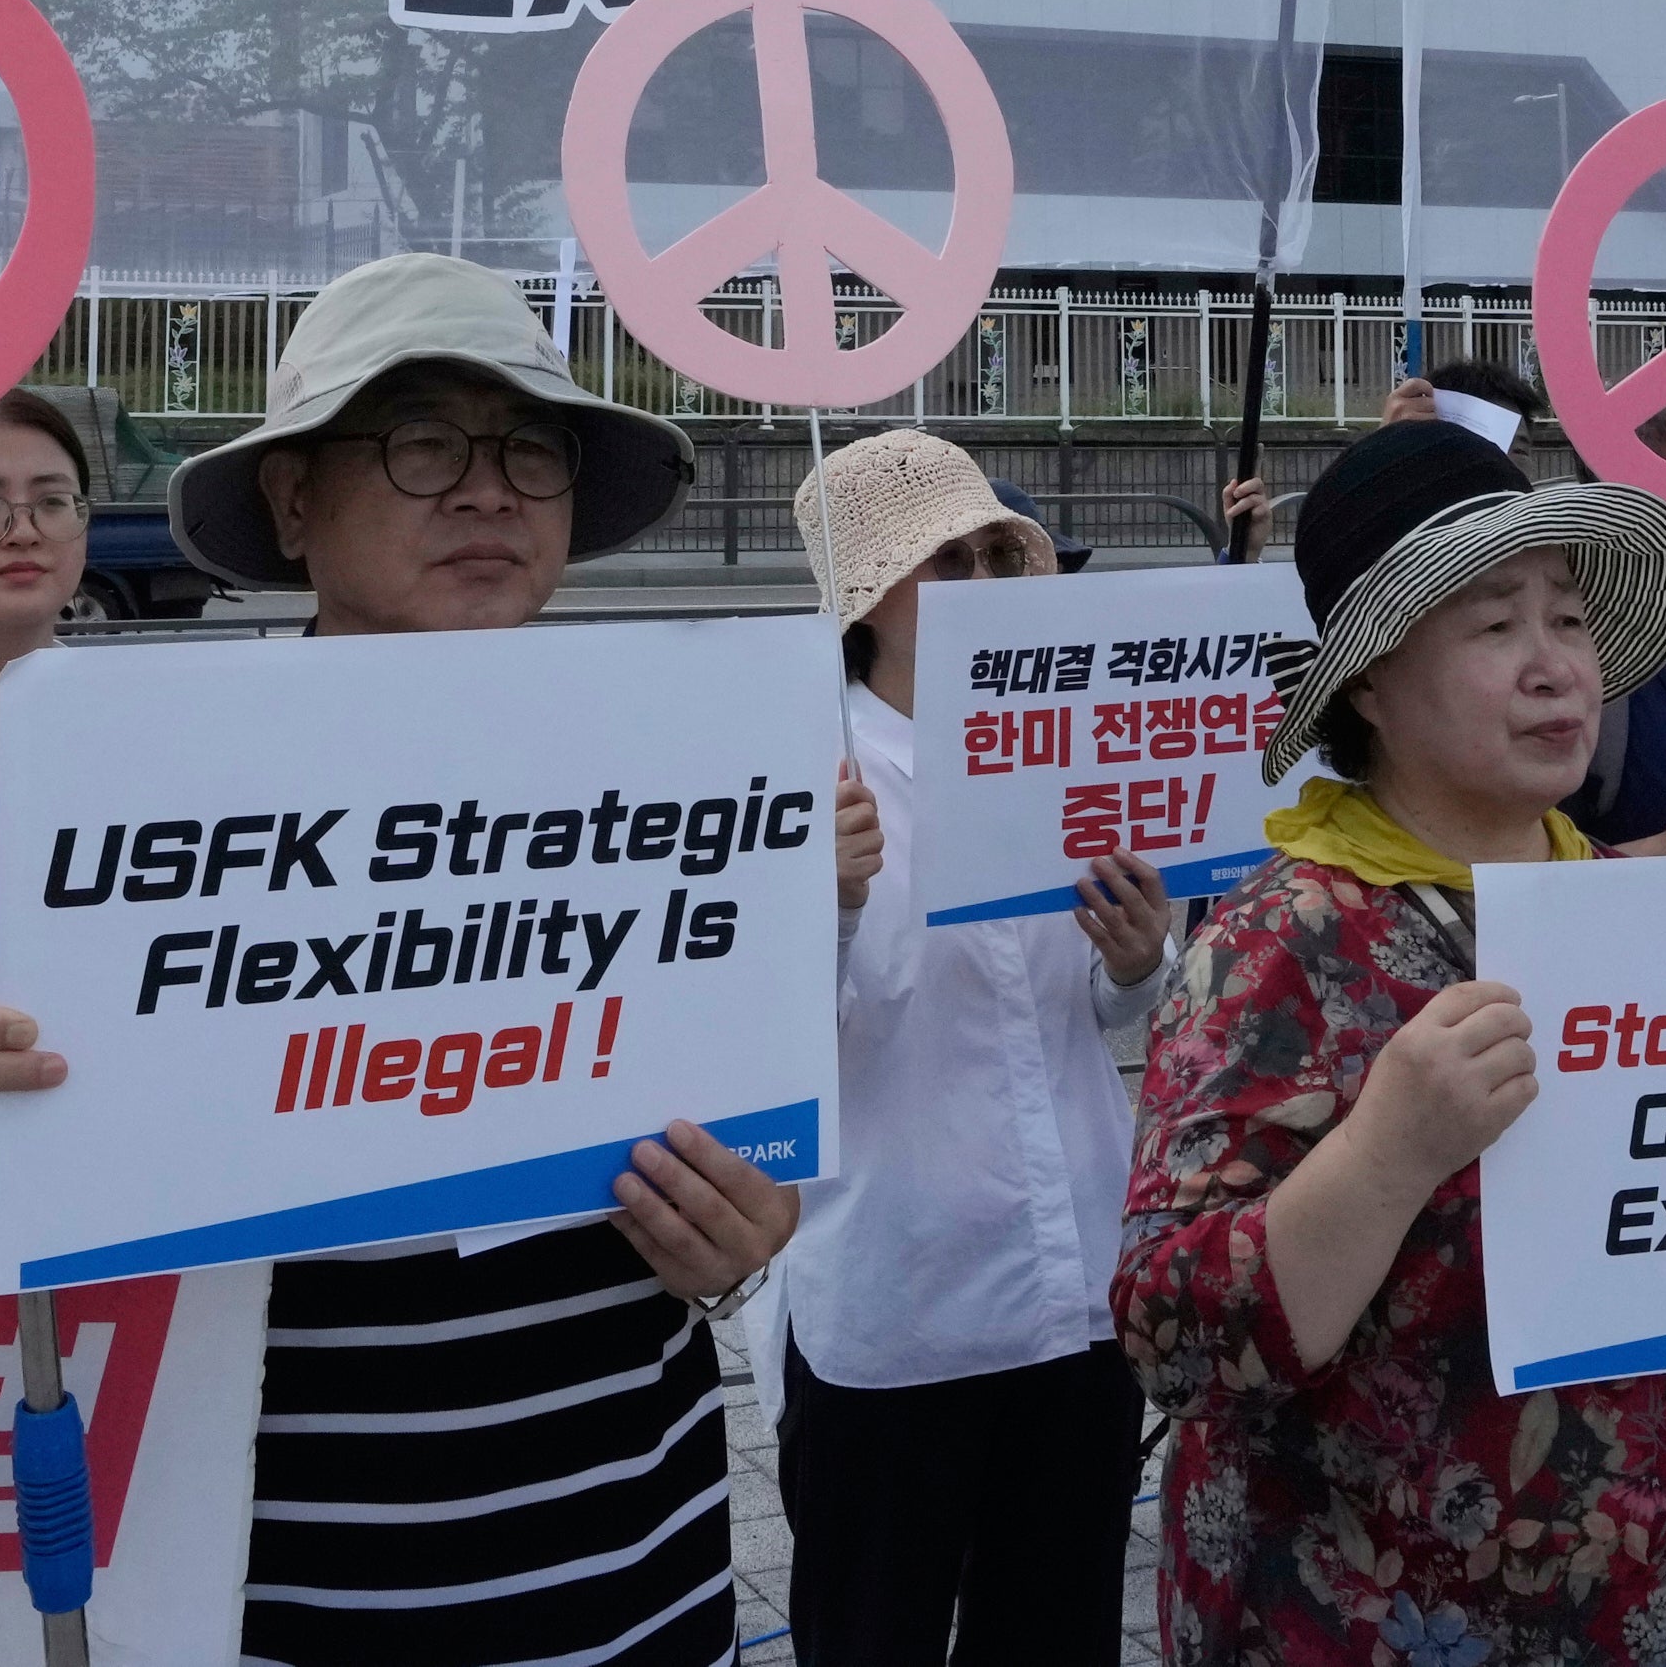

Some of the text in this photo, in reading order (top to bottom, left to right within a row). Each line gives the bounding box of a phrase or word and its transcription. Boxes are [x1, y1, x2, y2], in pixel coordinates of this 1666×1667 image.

[970, 631, 1282, 696] 핵대결 격화시키
[964, 707, 1072, 776] 한미
[44, 776, 815, 909] USFK Strategic
[1061, 773, 1217, 860] 중단!
[136, 888, 739, 1015] Flexibility Is
[728, 1139, 797, 1163] PARK
